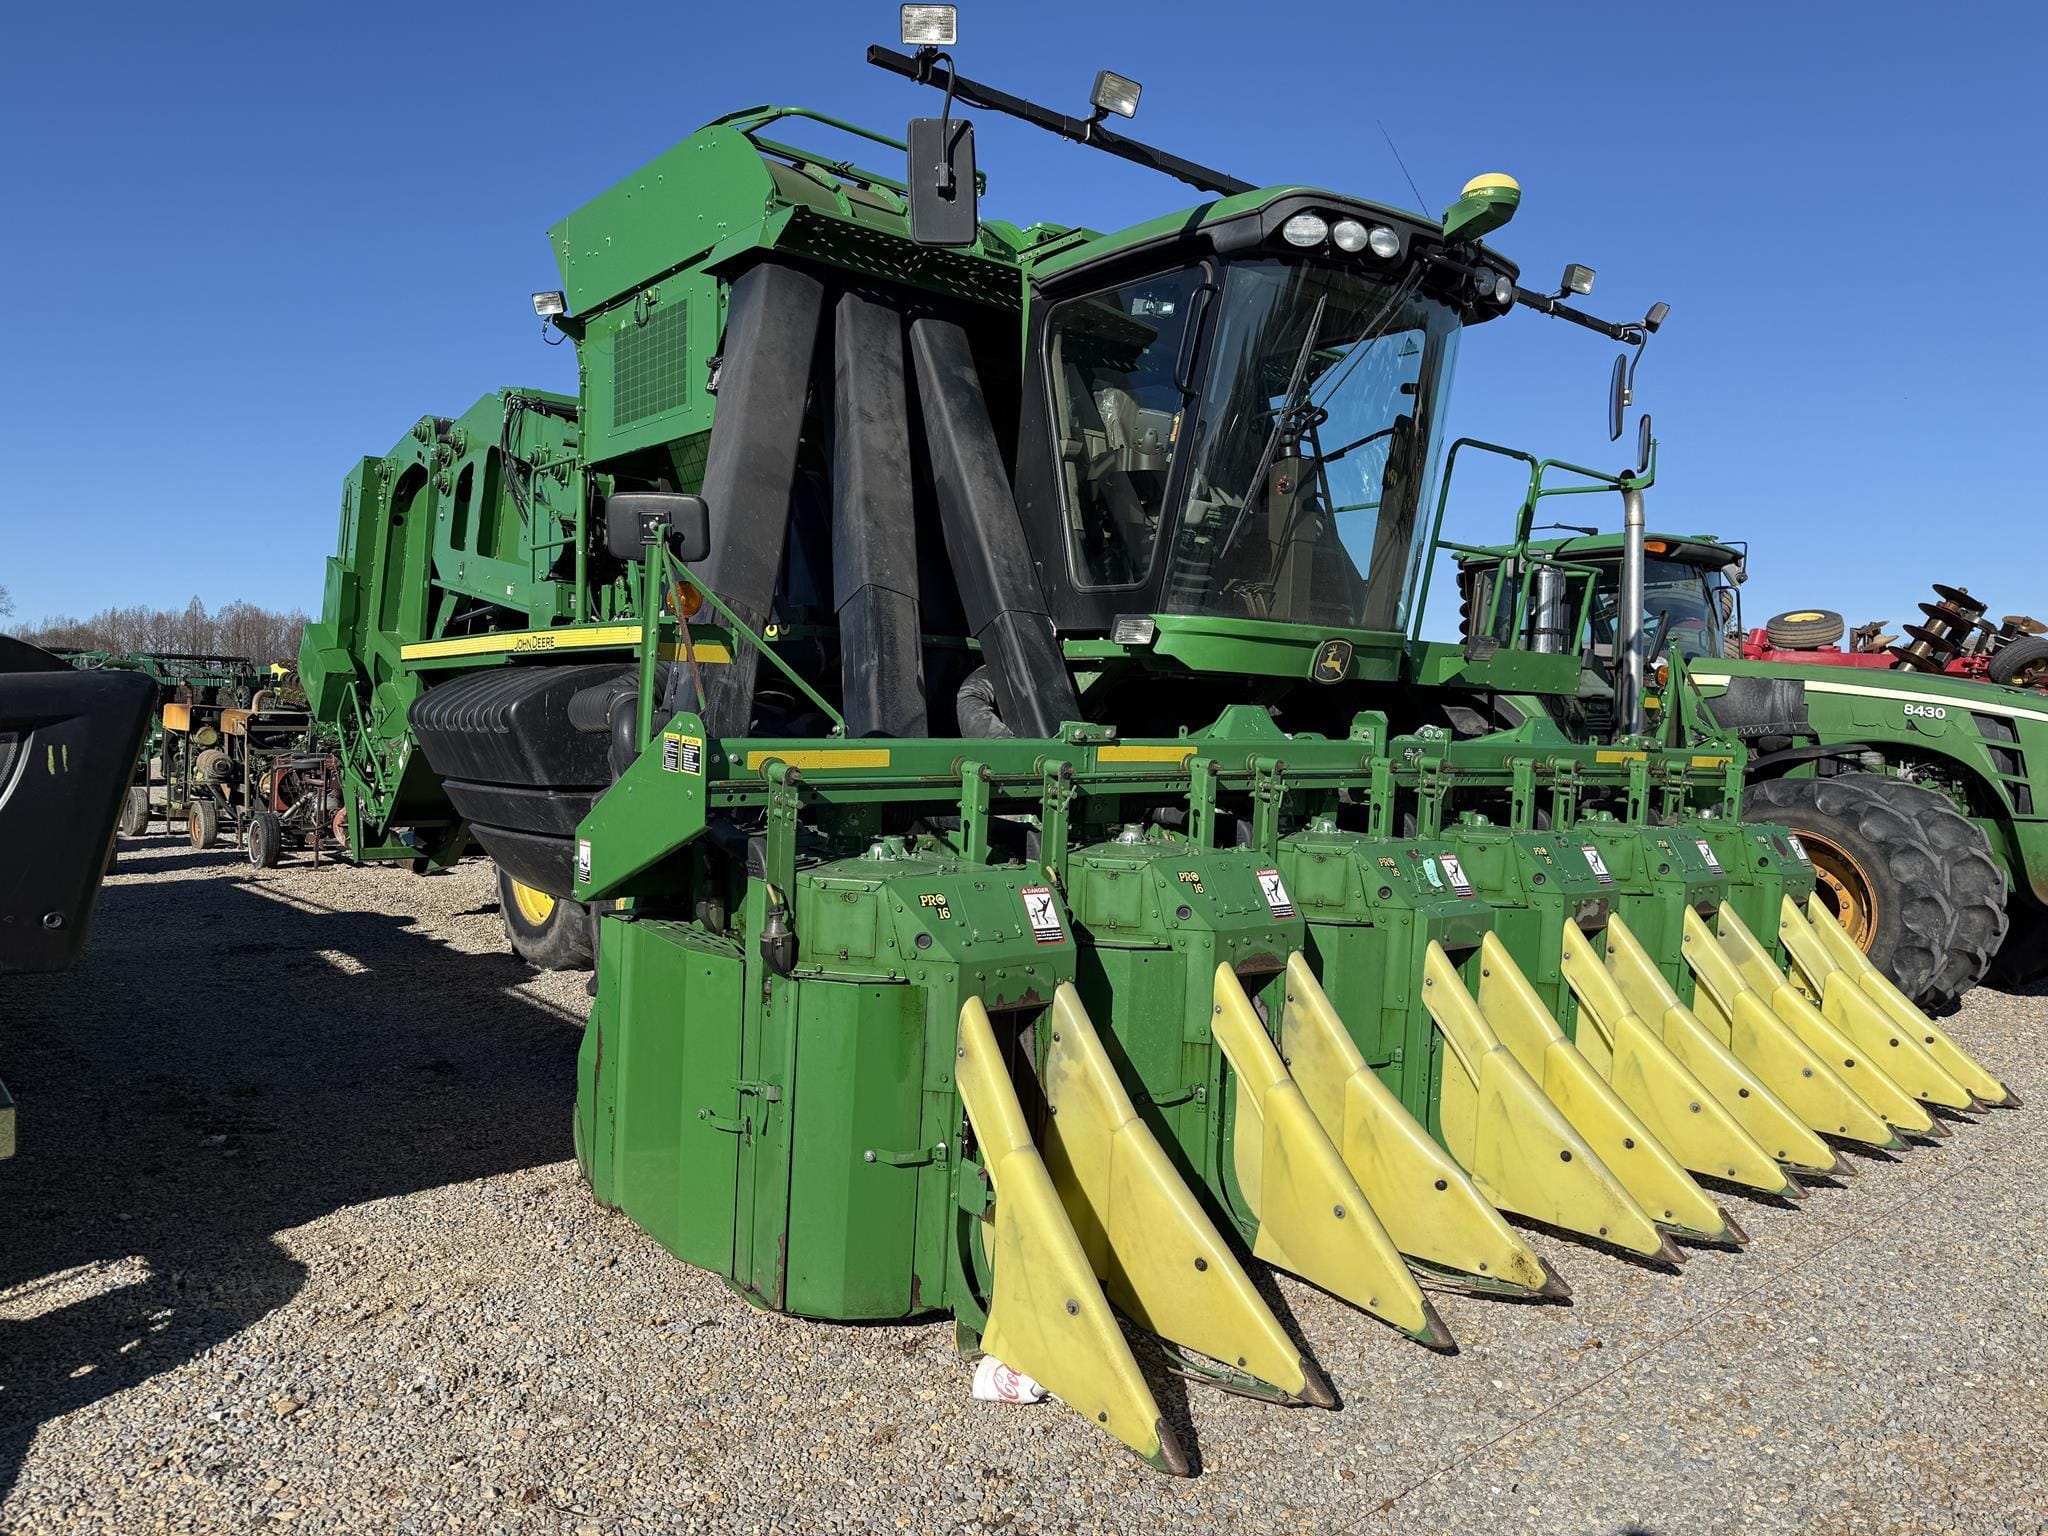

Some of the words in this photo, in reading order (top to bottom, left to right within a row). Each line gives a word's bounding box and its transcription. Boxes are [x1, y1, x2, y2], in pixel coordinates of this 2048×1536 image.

[514, 636, 532, 651] JOHN
[532, 636, 555, 649] DEERE
[1903, 703, 1946, 719] 8430
[1378, 857, 1396, 867] PRO
[1178, 871, 1200, 882] PRO
[1193, 883, 1204, 893] 16
[919, 893, 946, 907] PRO
[937, 907, 951, 920] 16
